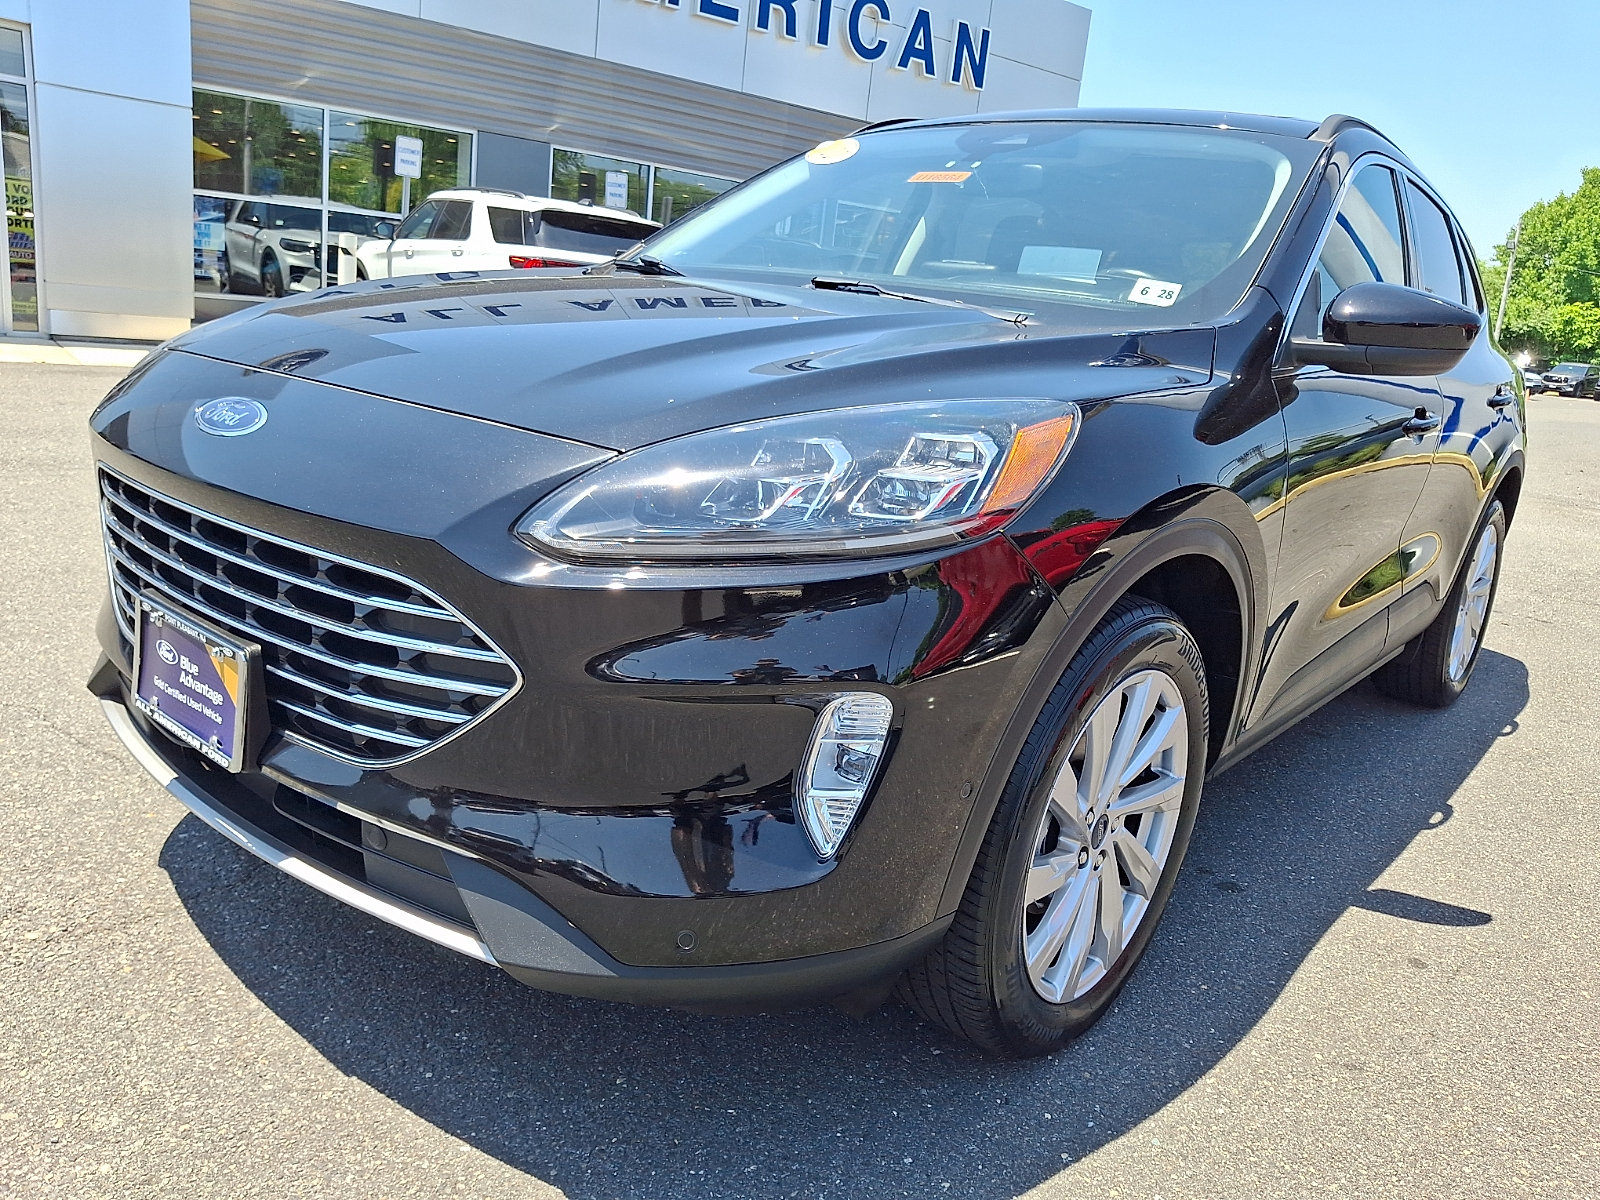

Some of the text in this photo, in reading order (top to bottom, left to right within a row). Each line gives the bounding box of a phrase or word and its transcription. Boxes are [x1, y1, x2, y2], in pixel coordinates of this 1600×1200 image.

[641, 0, 991, 91] RICAN
[10, 251, 33, 260] AUTO
[1141, 286, 1175, 300] 6 28
[204, 401, 250, 426] Ford
[158, 641, 177, 662] Ford
[180, 655, 199, 676] Blue
[154, 675, 223, 725] Gold Certified Used Vehicle
[179, 671, 224, 706] Advantage
[135, 700, 229, 768] ALL AMERICAN FORD
